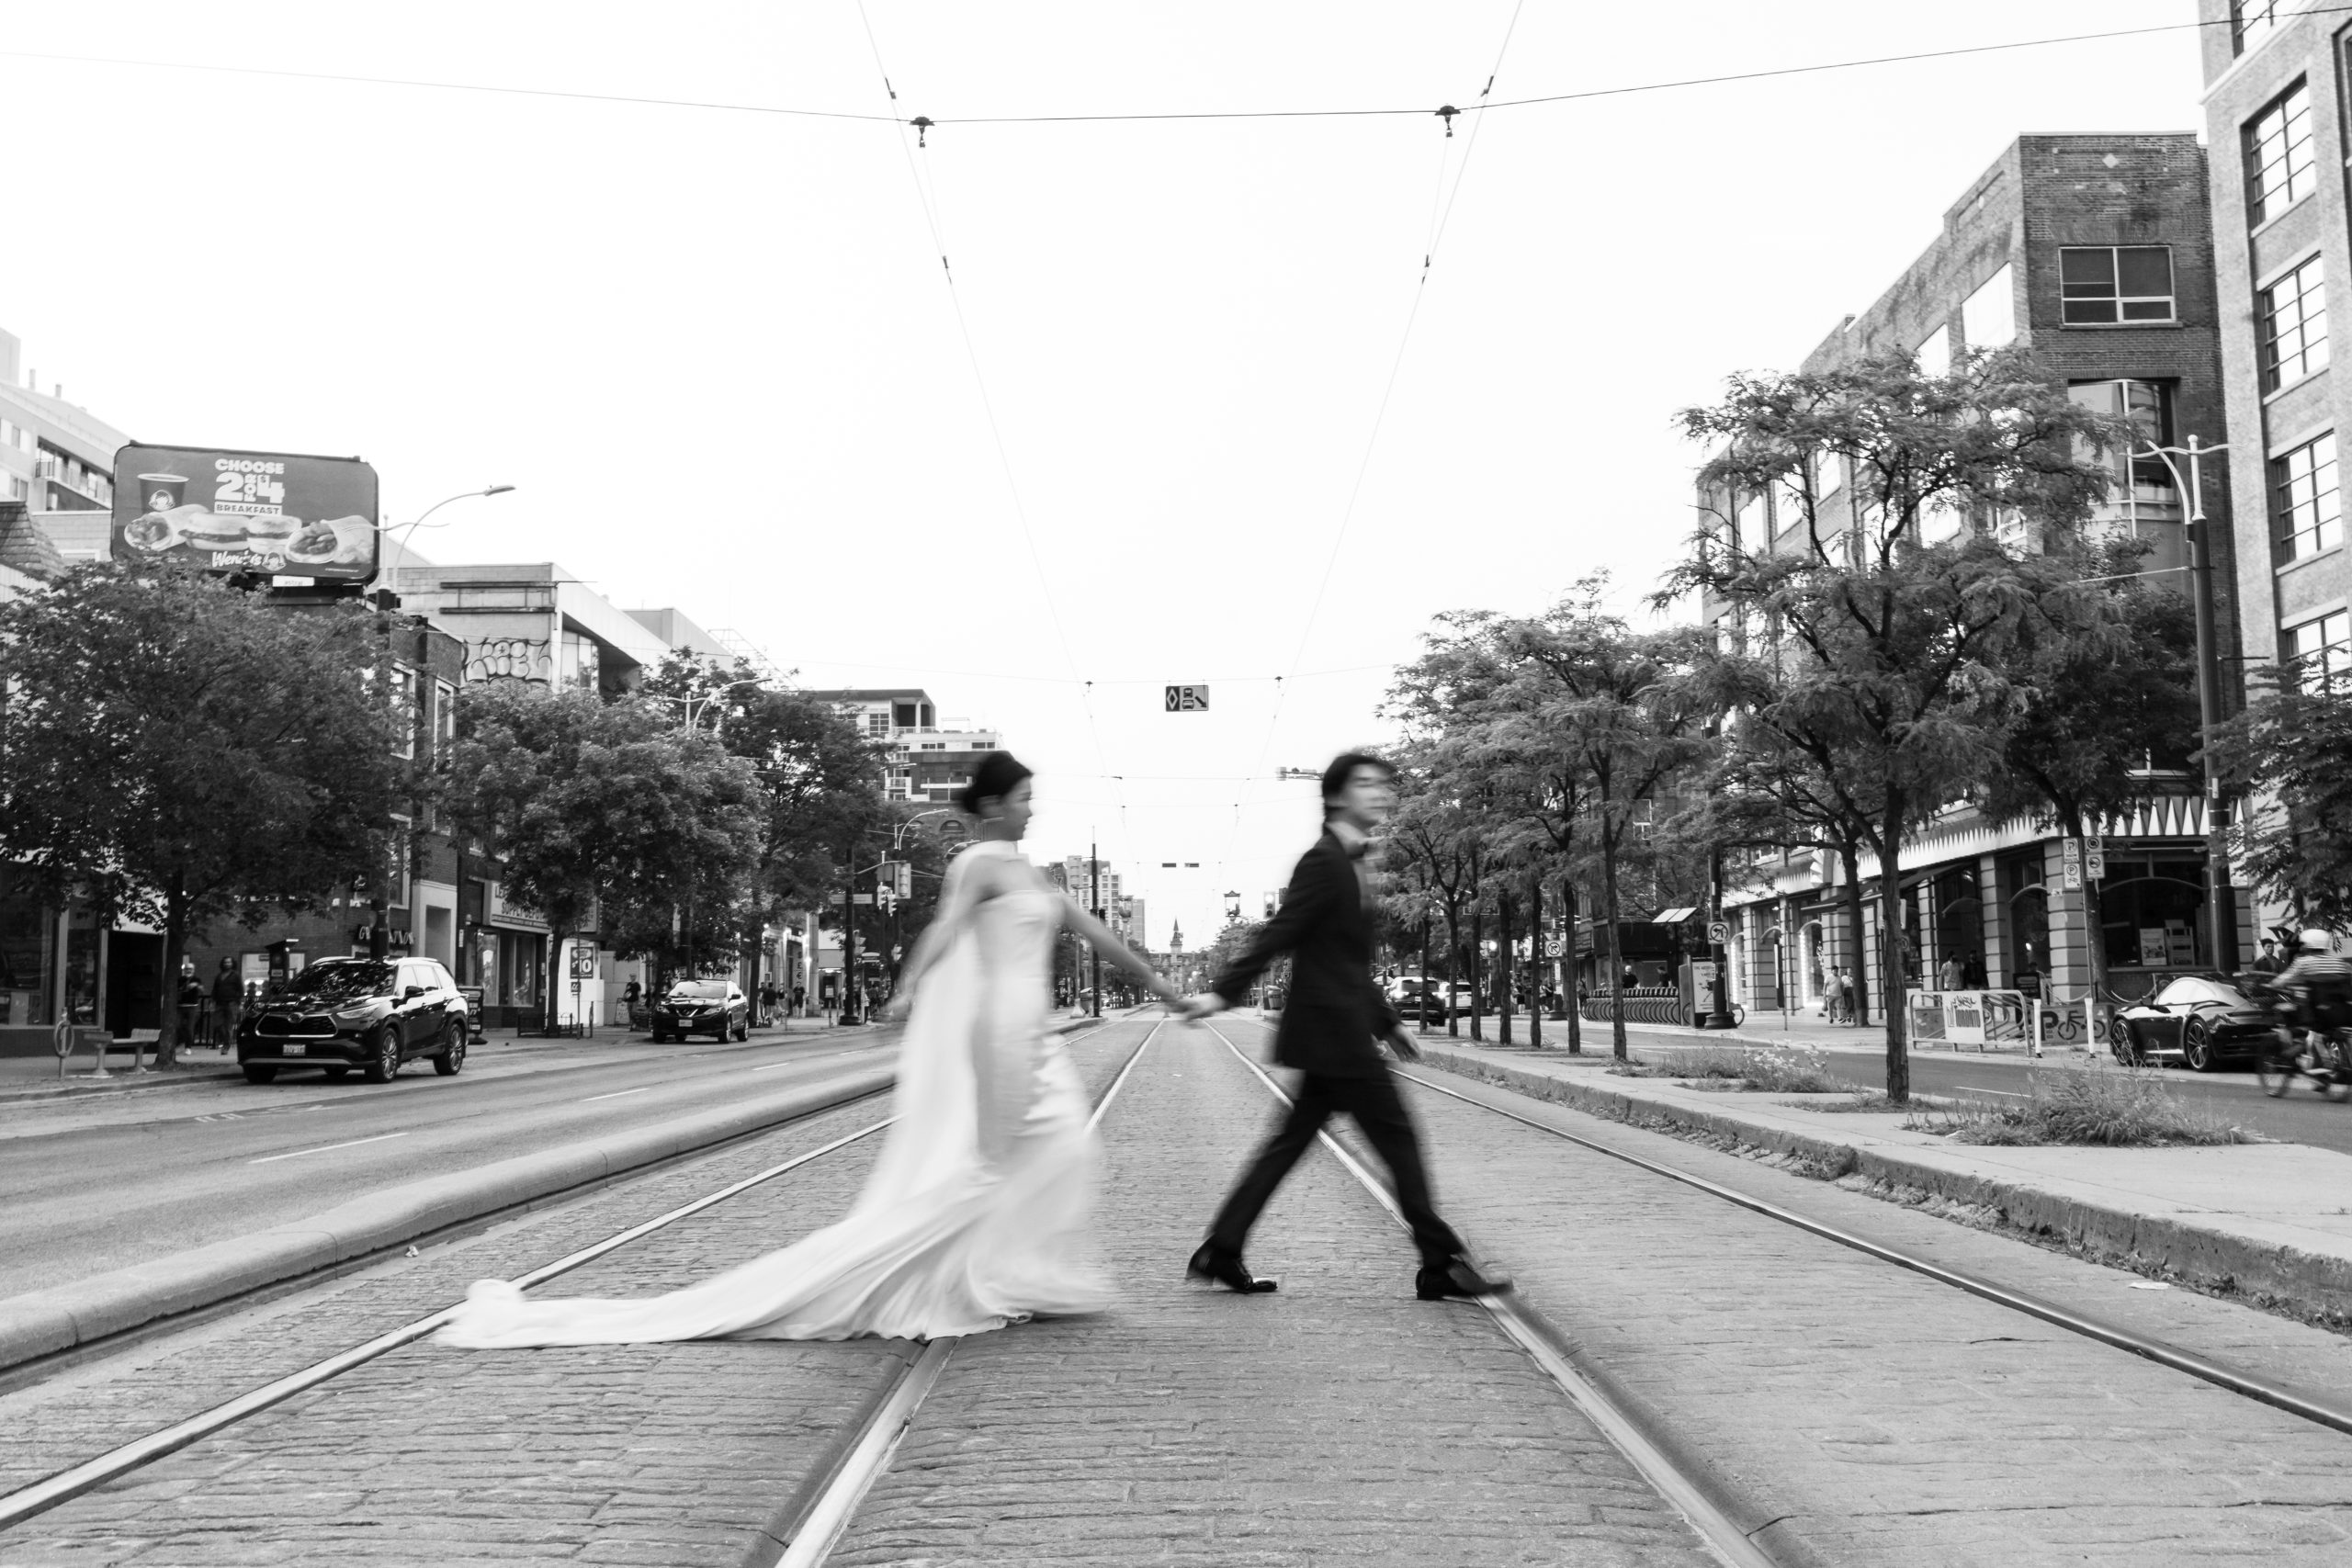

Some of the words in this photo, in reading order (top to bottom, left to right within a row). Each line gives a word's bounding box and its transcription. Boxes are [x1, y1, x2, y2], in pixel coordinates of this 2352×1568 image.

[215, 458, 285, 474] CHOOSE
[214, 471, 243, 502] 2
[243, 473, 257, 502] FOR
[216, 504, 279, 514] BREAKFAST
